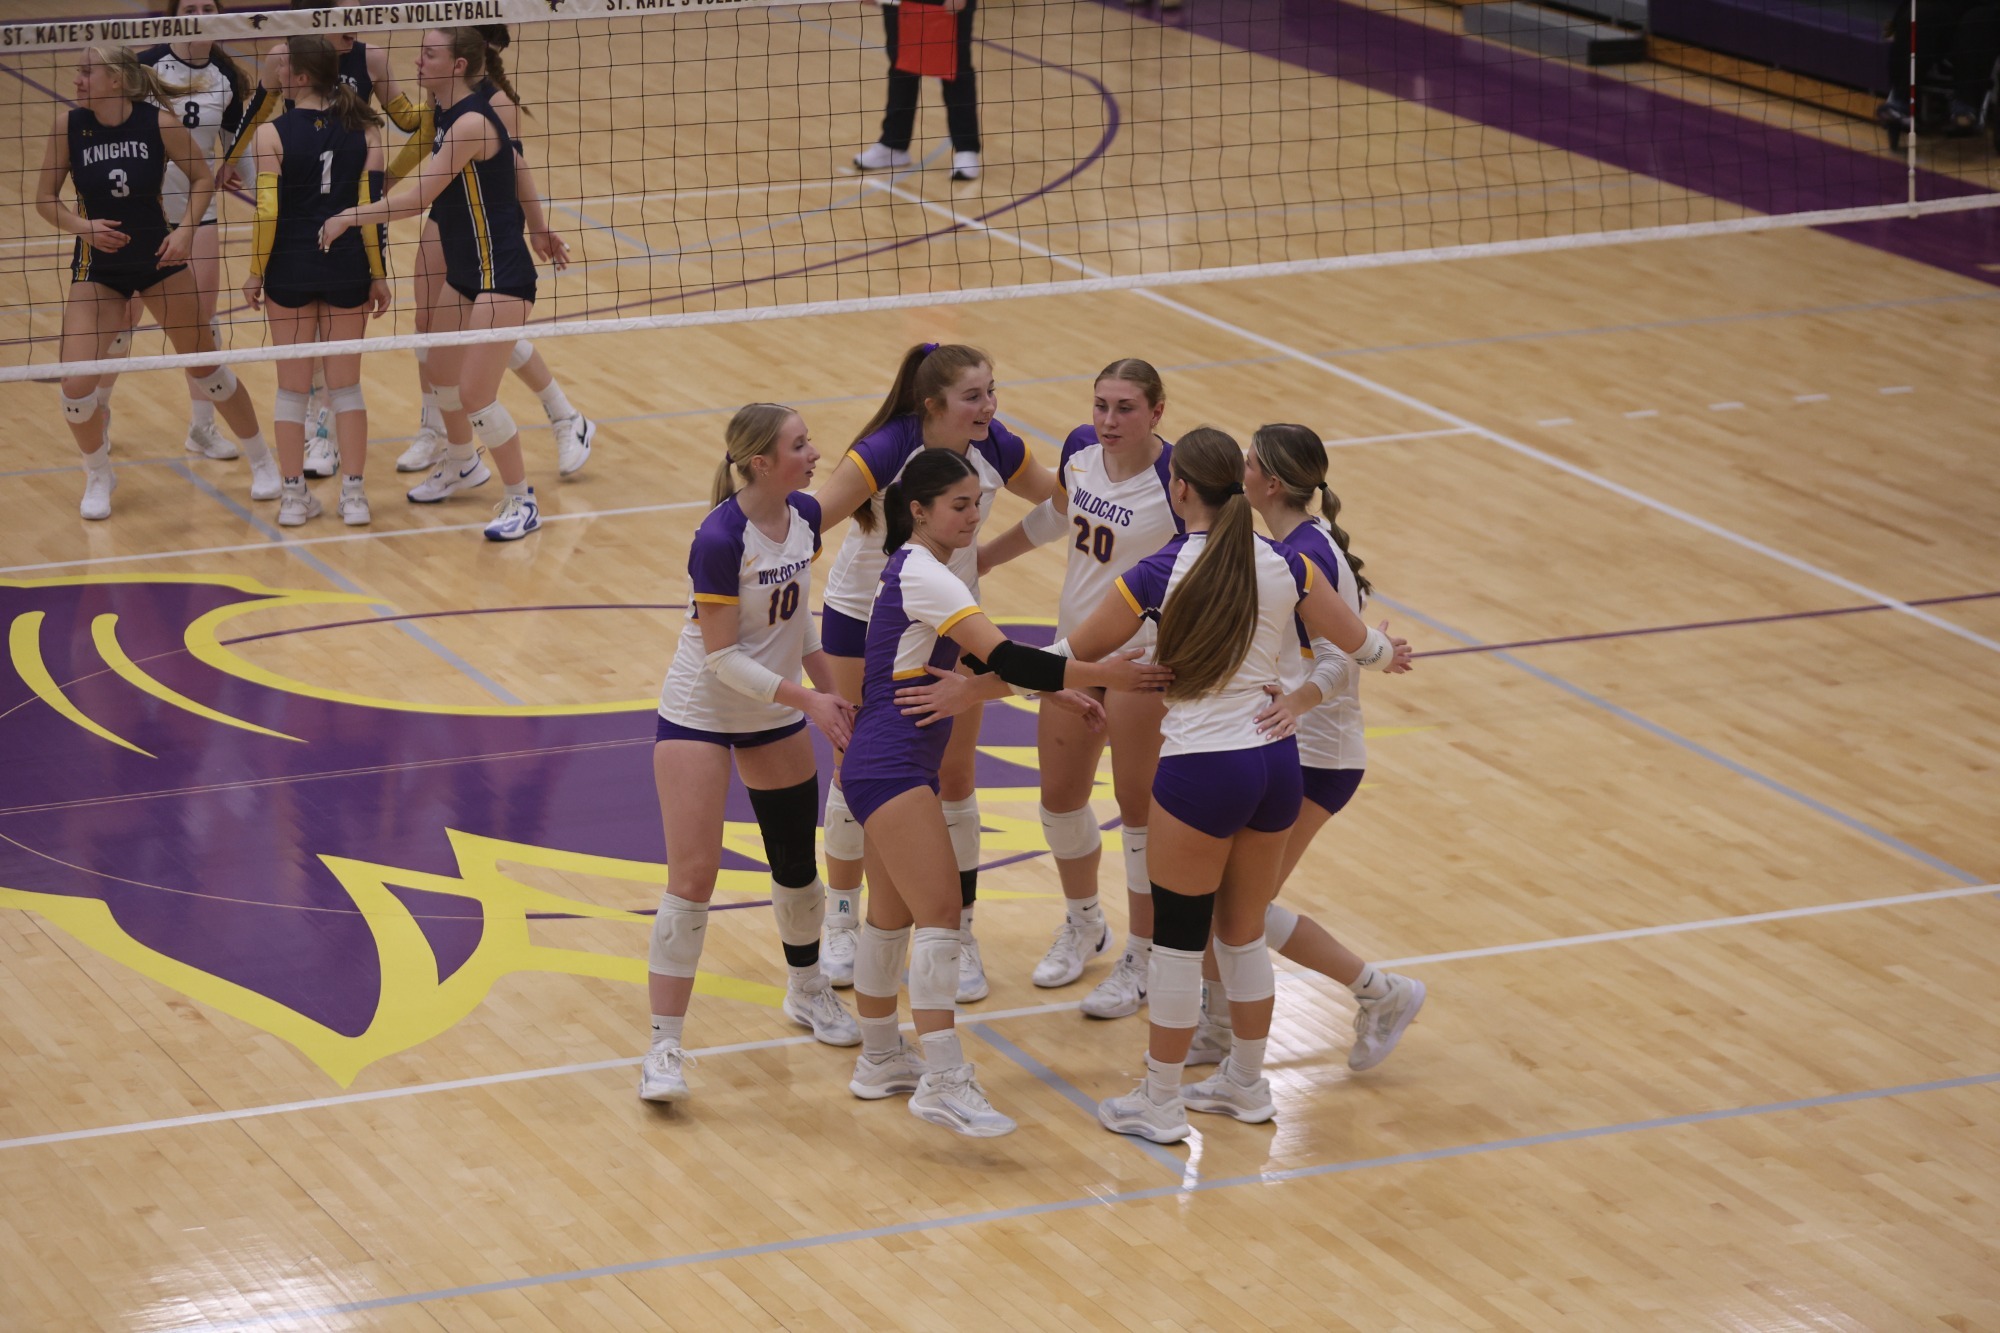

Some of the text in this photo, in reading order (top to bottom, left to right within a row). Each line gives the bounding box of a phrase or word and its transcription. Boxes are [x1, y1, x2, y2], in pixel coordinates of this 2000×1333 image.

[312, 0, 503, 28] ST. KATE'S VOLLEYBALL
[3, 17, 202, 46] ST. KATE'S VOLLEYBALL
[182, 100, 200, 129] 8
[83, 141, 149, 167] KNIGHTS
[108, 168, 130, 198] 3
[319, 150, 334, 194] 1
[1073, 486, 1134, 527] WILDCATS
[1073, 514, 1115, 564] 20
[768, 581, 799, 627] 10
